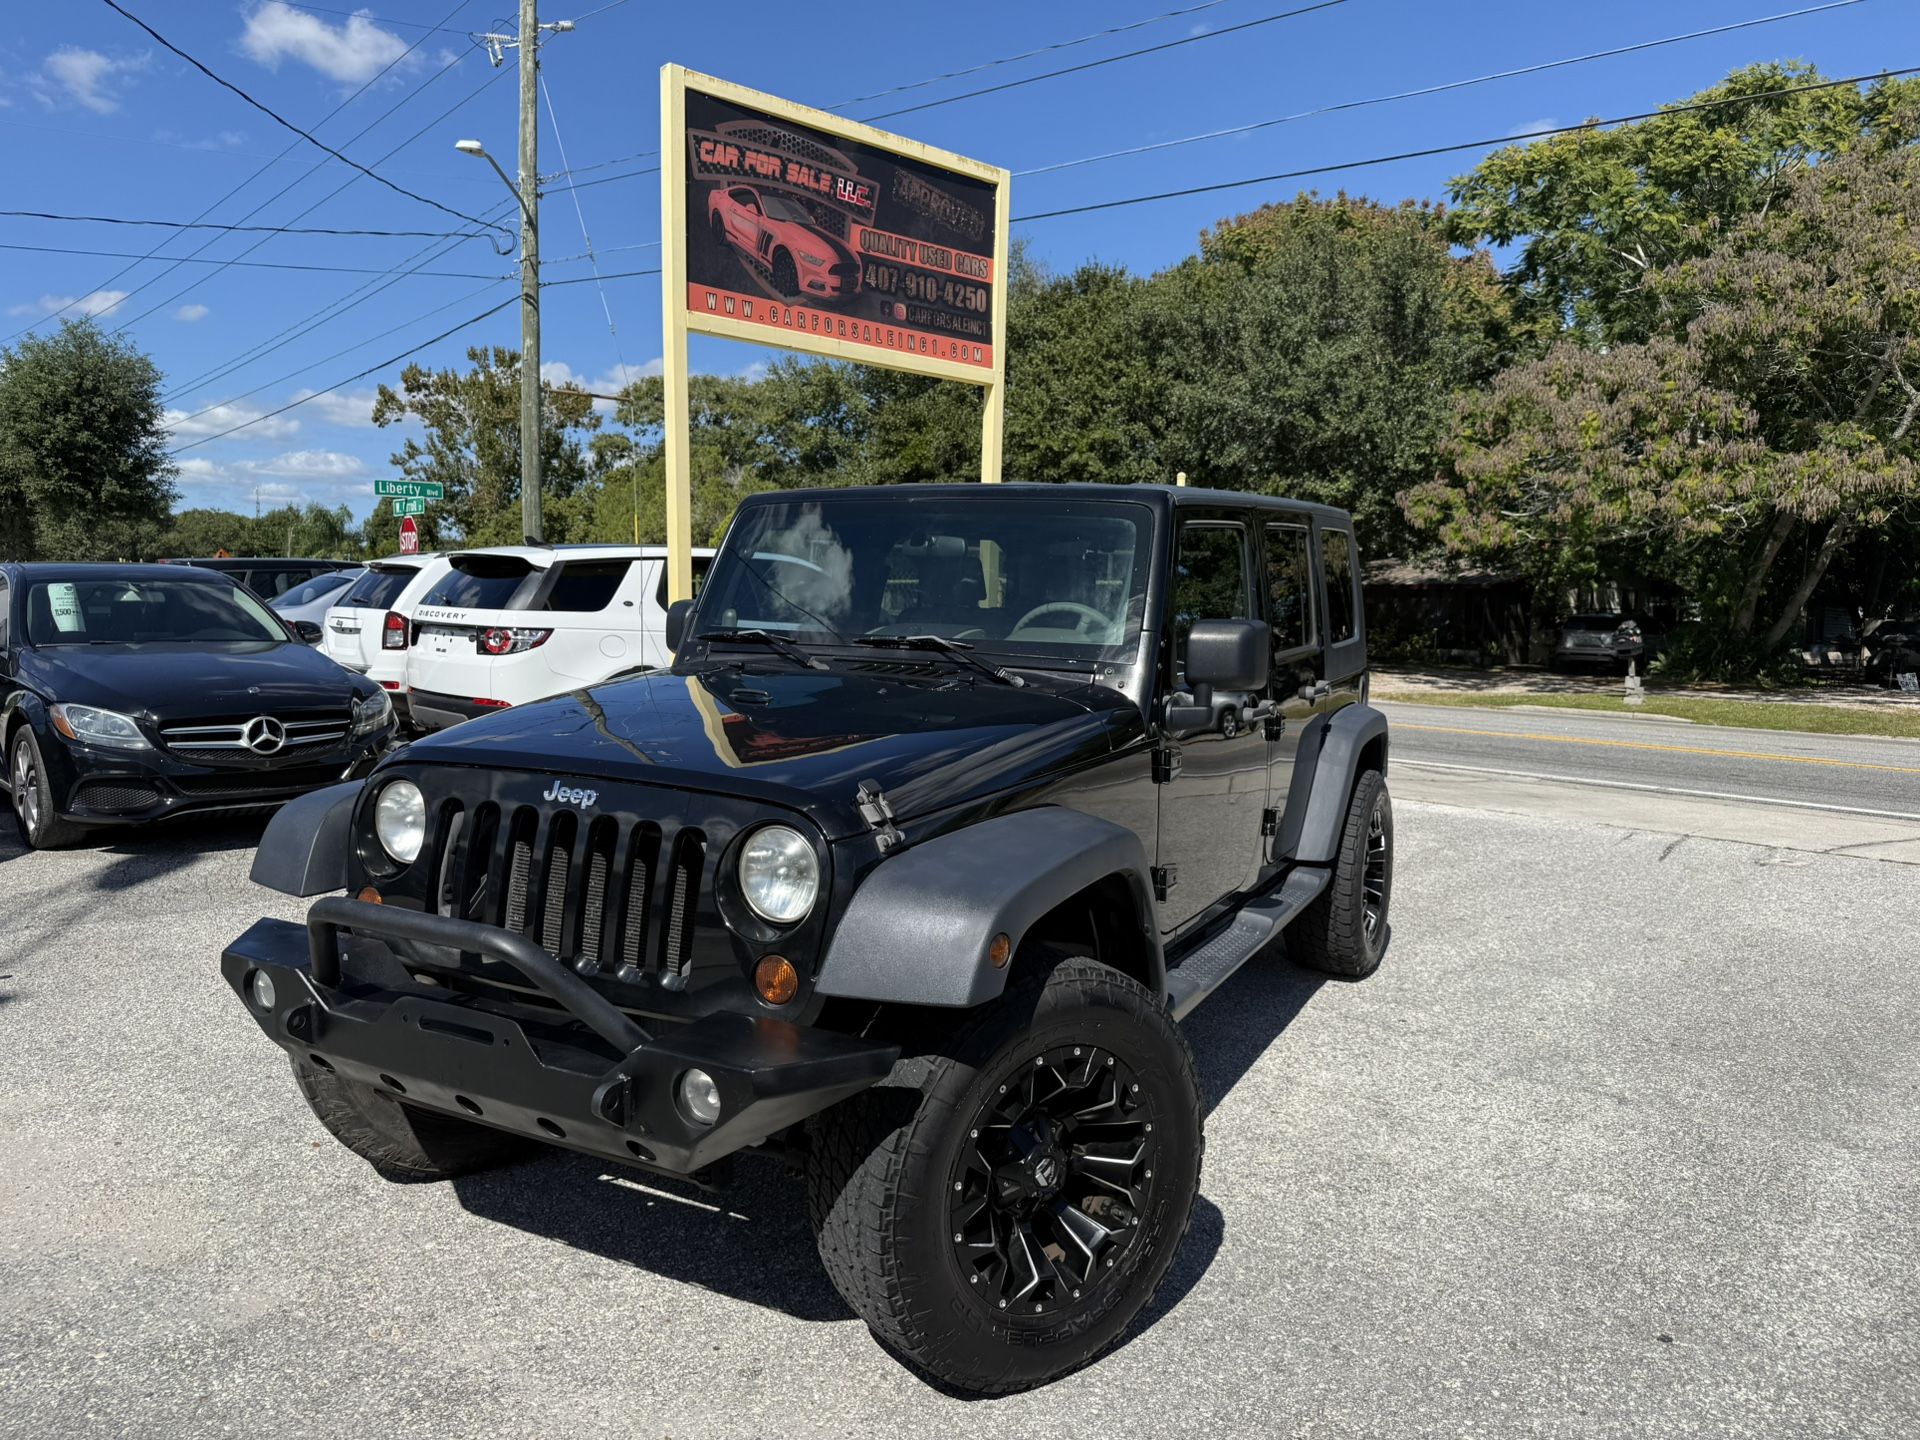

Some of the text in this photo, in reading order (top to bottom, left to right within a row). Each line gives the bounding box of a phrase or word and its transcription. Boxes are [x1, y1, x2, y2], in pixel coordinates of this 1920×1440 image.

[700, 140, 741, 169] CAR
[744, 150, 782, 178] FOR
[787, 161, 833, 194] SALE
[859, 228, 989, 279] QUALITY USED CARS
[865, 262, 988, 313] 407-910-4250
[378, 481, 439, 498] Liberty Blvd
[400, 531, 418, 551] STOP
[418, 609, 467, 620] DISCOVERY
[543, 780, 598, 810] Jeep
